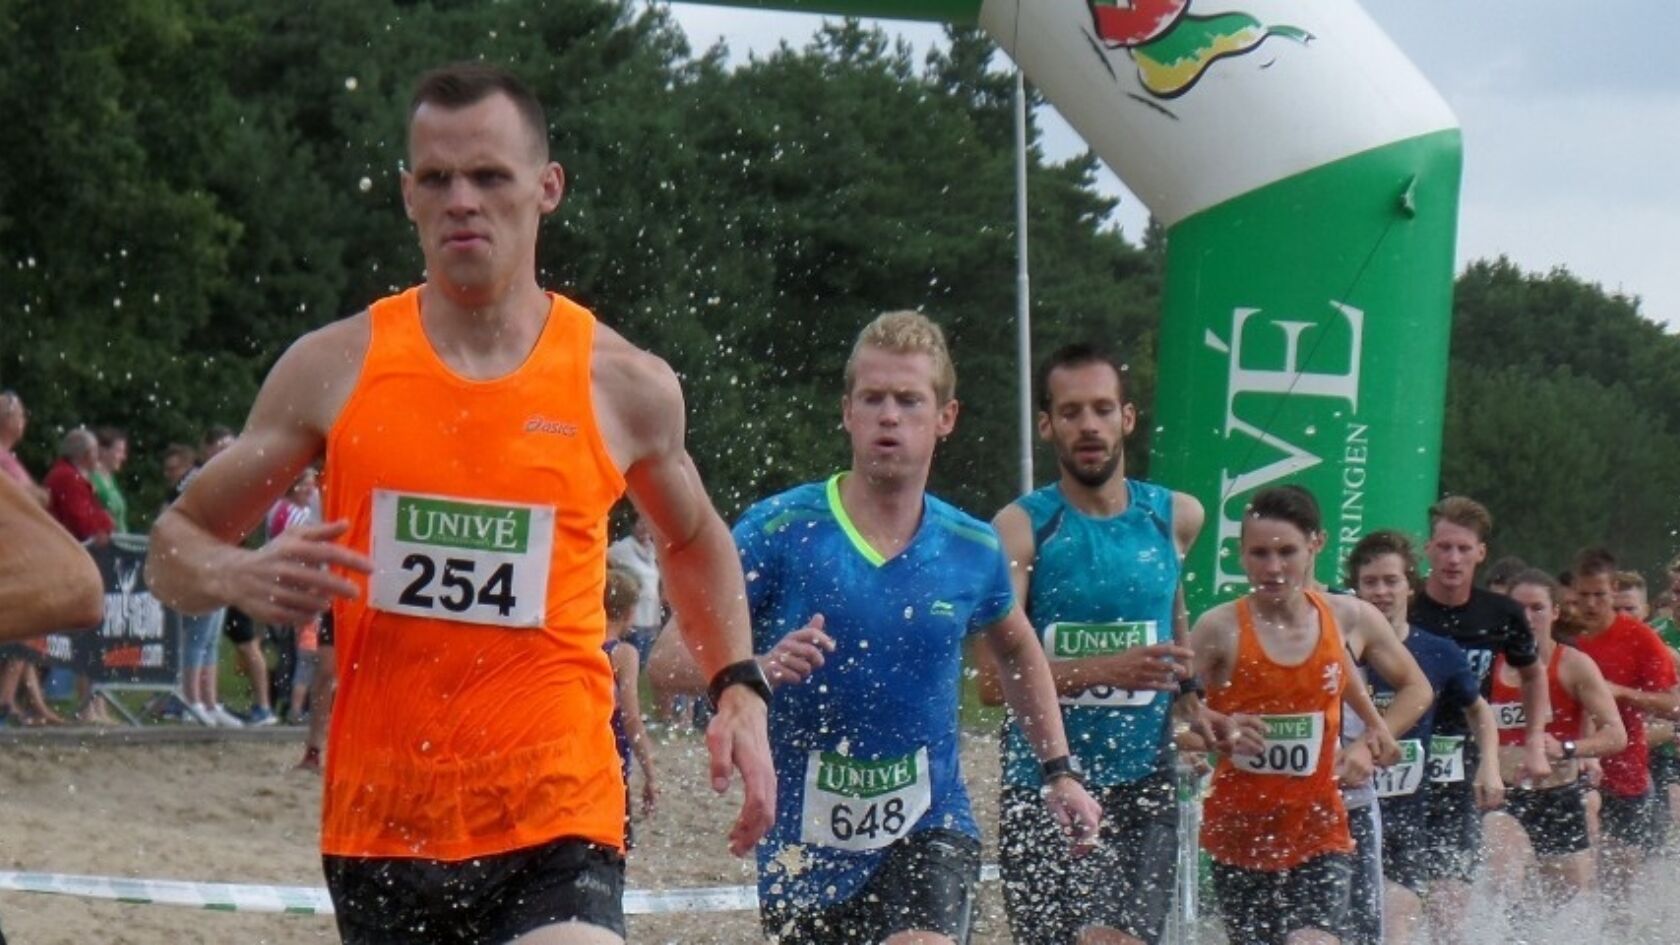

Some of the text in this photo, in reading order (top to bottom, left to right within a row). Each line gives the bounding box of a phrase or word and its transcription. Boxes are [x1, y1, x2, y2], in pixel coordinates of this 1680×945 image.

[1204, 300, 1364, 594] VÉ
[408, 504, 518, 549] UNIVÉ
[398, 553, 517, 617] 254
[1061, 625, 1141, 654] UNIVÉ
[826, 753, 913, 790] UNIVÉ
[1373, 764, 1412, 793] 17
[830, 796, 906, 841] 648
